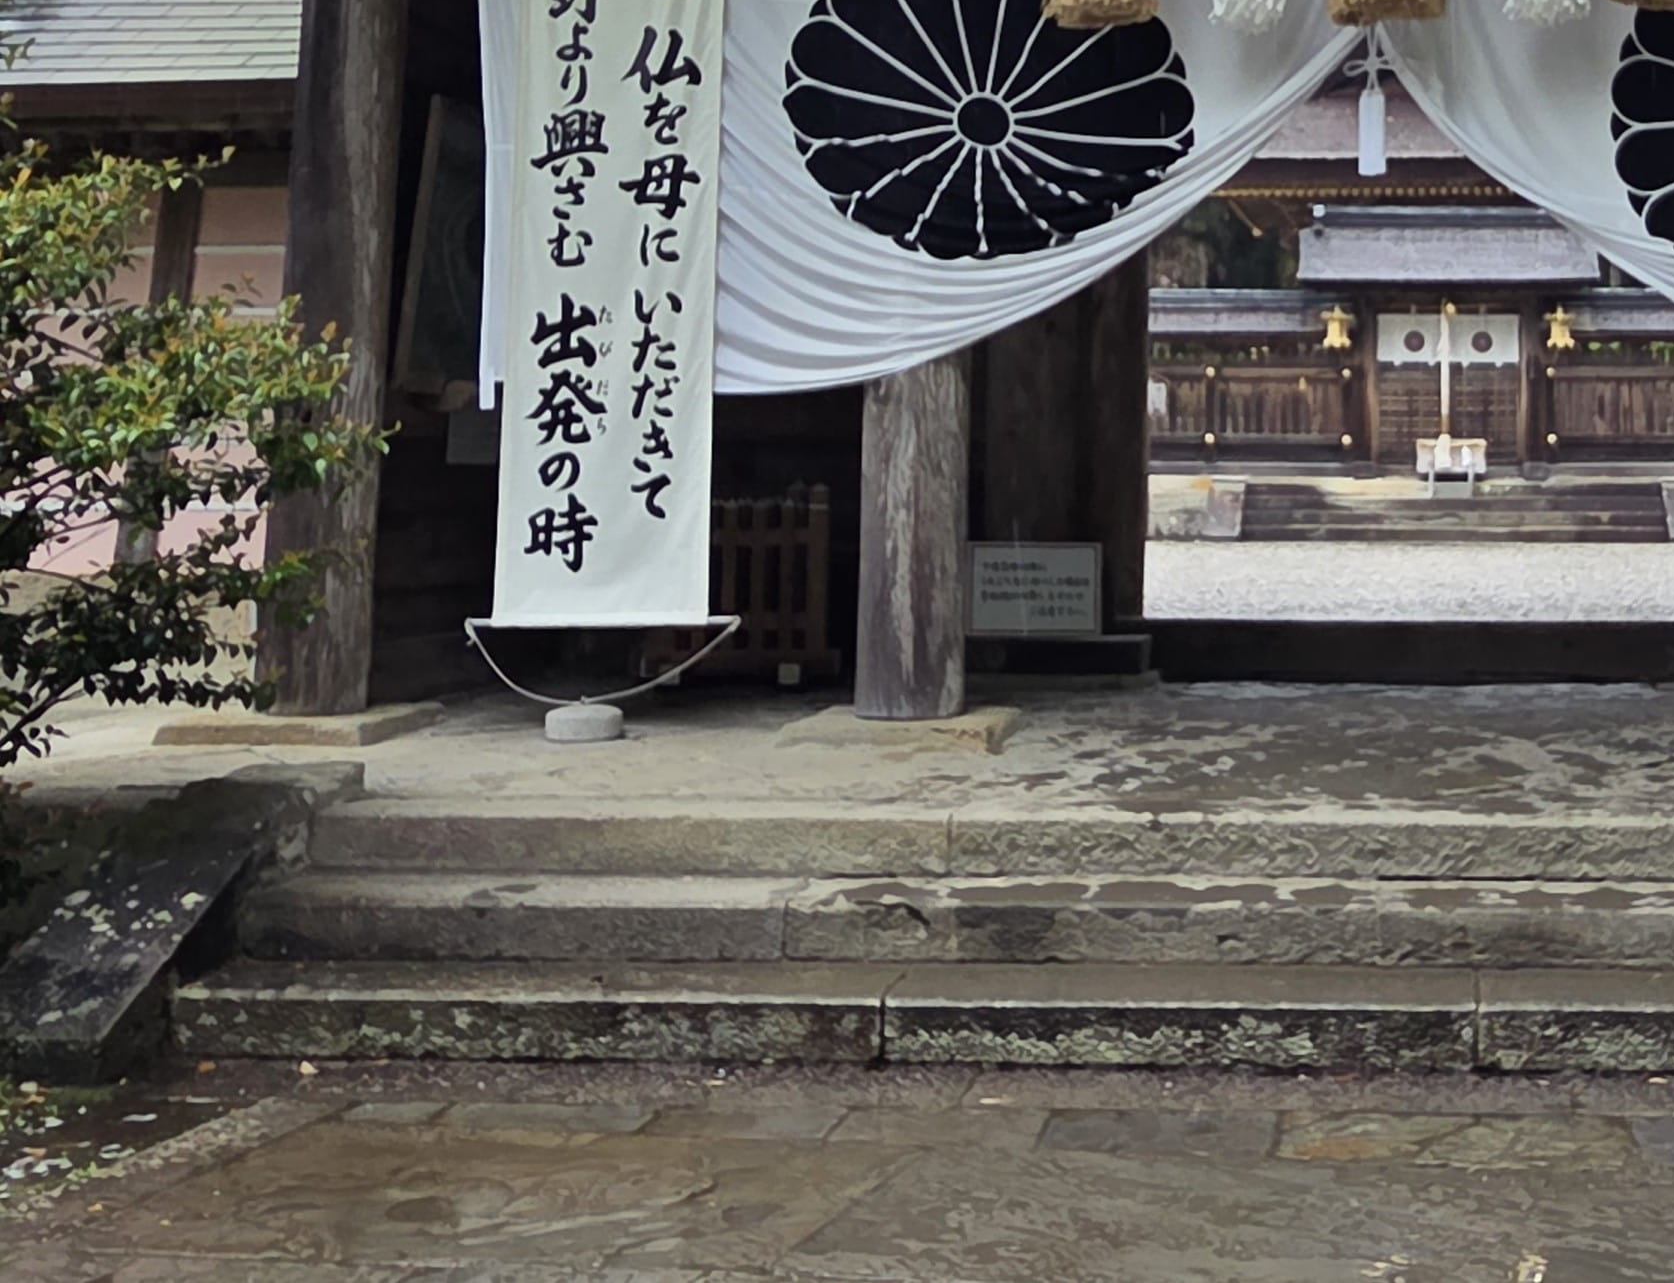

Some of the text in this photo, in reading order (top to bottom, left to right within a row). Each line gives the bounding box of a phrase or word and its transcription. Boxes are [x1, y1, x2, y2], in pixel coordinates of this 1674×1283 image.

[619, 25, 702, 266] 仏を母に
[524, 293, 607, 573] 出発の時
[631, 289, 683, 519] いただきて
